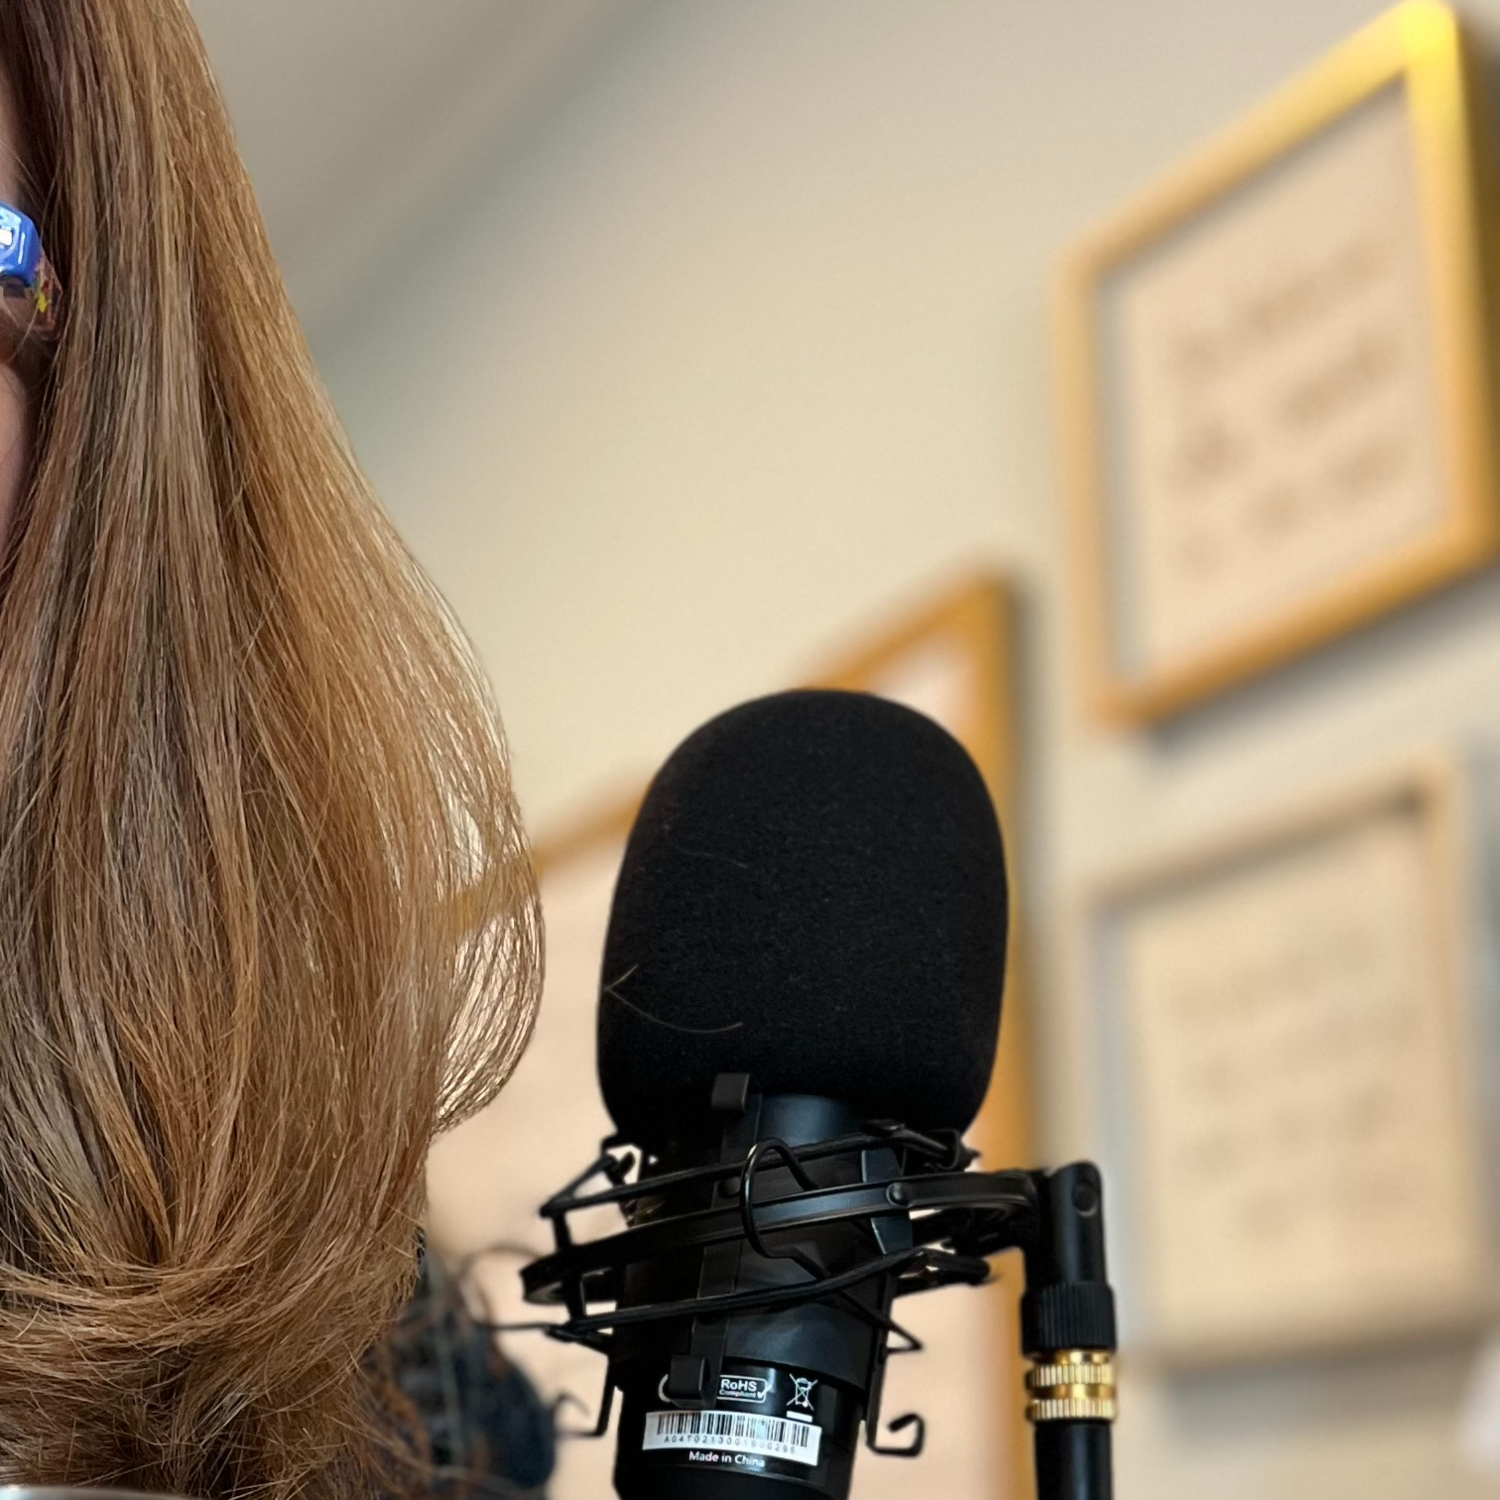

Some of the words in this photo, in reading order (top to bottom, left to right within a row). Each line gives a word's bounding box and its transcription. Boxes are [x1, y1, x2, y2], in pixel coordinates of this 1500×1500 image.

[720, 1379, 758, 1391] RoHS
[688, 1450, 720, 1462] Made
[721, 1452, 732, 1464] in
[734, 1454, 766, 1468] China
